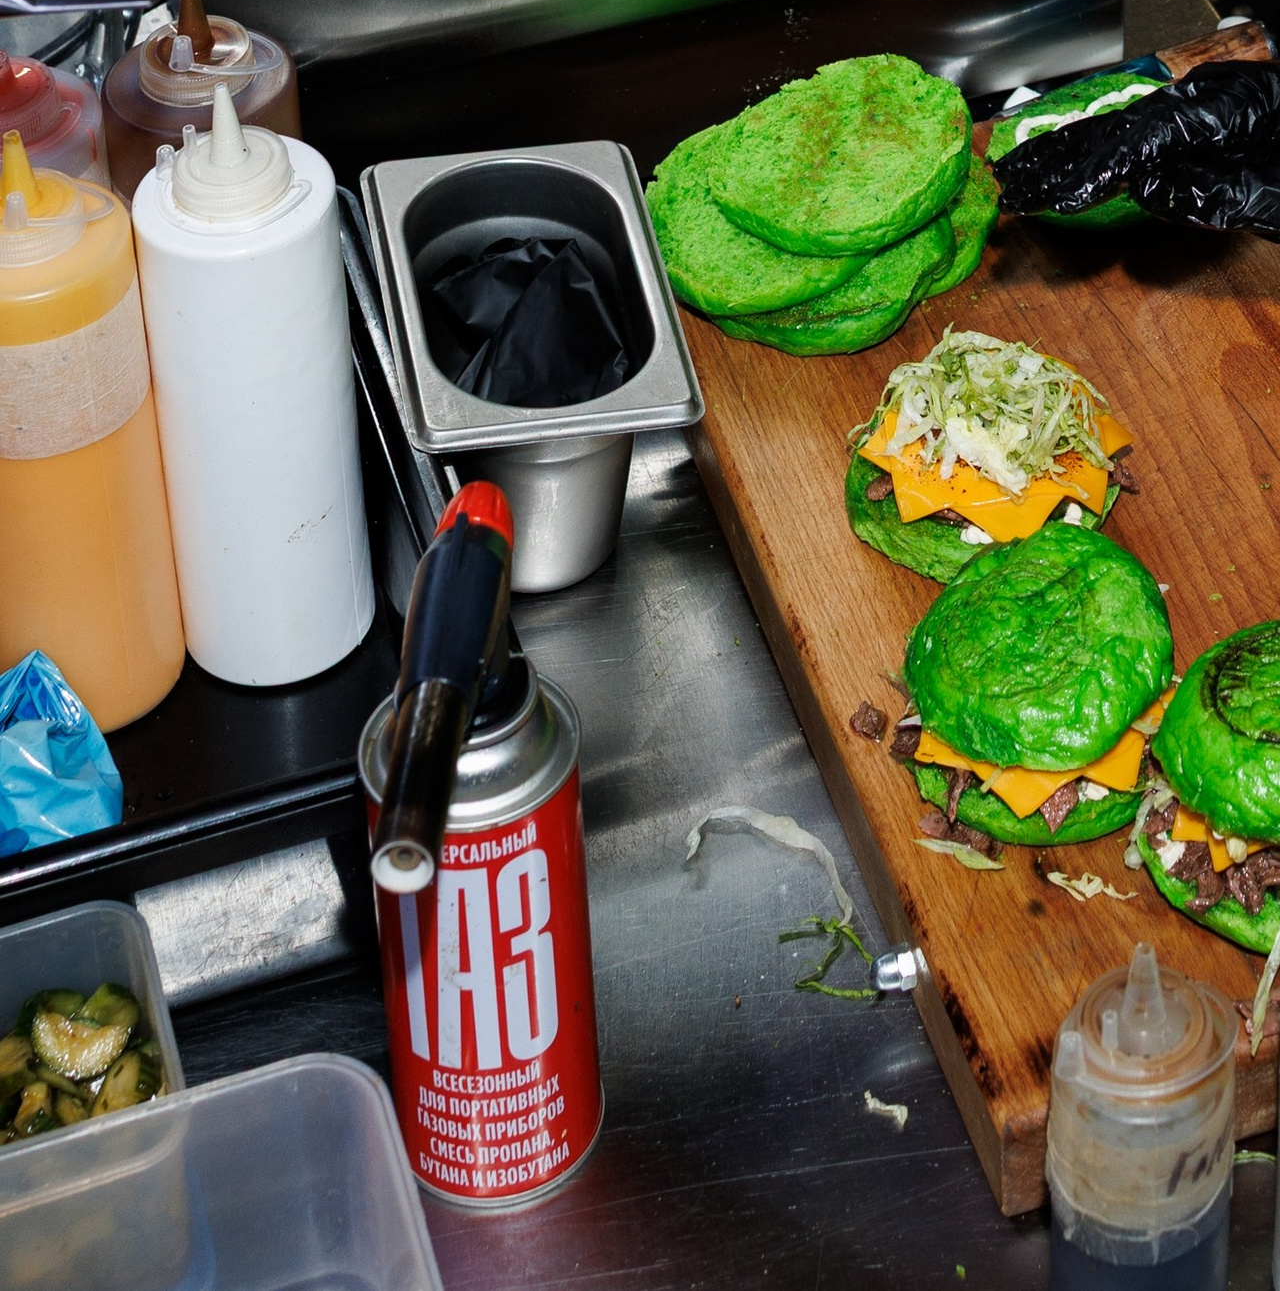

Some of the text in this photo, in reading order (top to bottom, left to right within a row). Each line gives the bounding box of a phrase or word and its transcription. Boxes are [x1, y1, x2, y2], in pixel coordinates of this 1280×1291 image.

[441, 820, 537, 864] ЕРСАЛЬНЫЙ
[419, 1074, 560, 1117] ДЛЯ ПОРТАТИВНЫХ
[432, 1060, 541, 1094] ВСЕСЕЗОННЫЙ
[417, 1095, 565, 1142] ГАЗОВЫХ ПРИБОРОВ
[419, 1141, 570, 1188] БУТАНА И ИЗОБУТАНА
[429, 1130, 556, 1165] СМЕСЬ ПРОПАНА,
